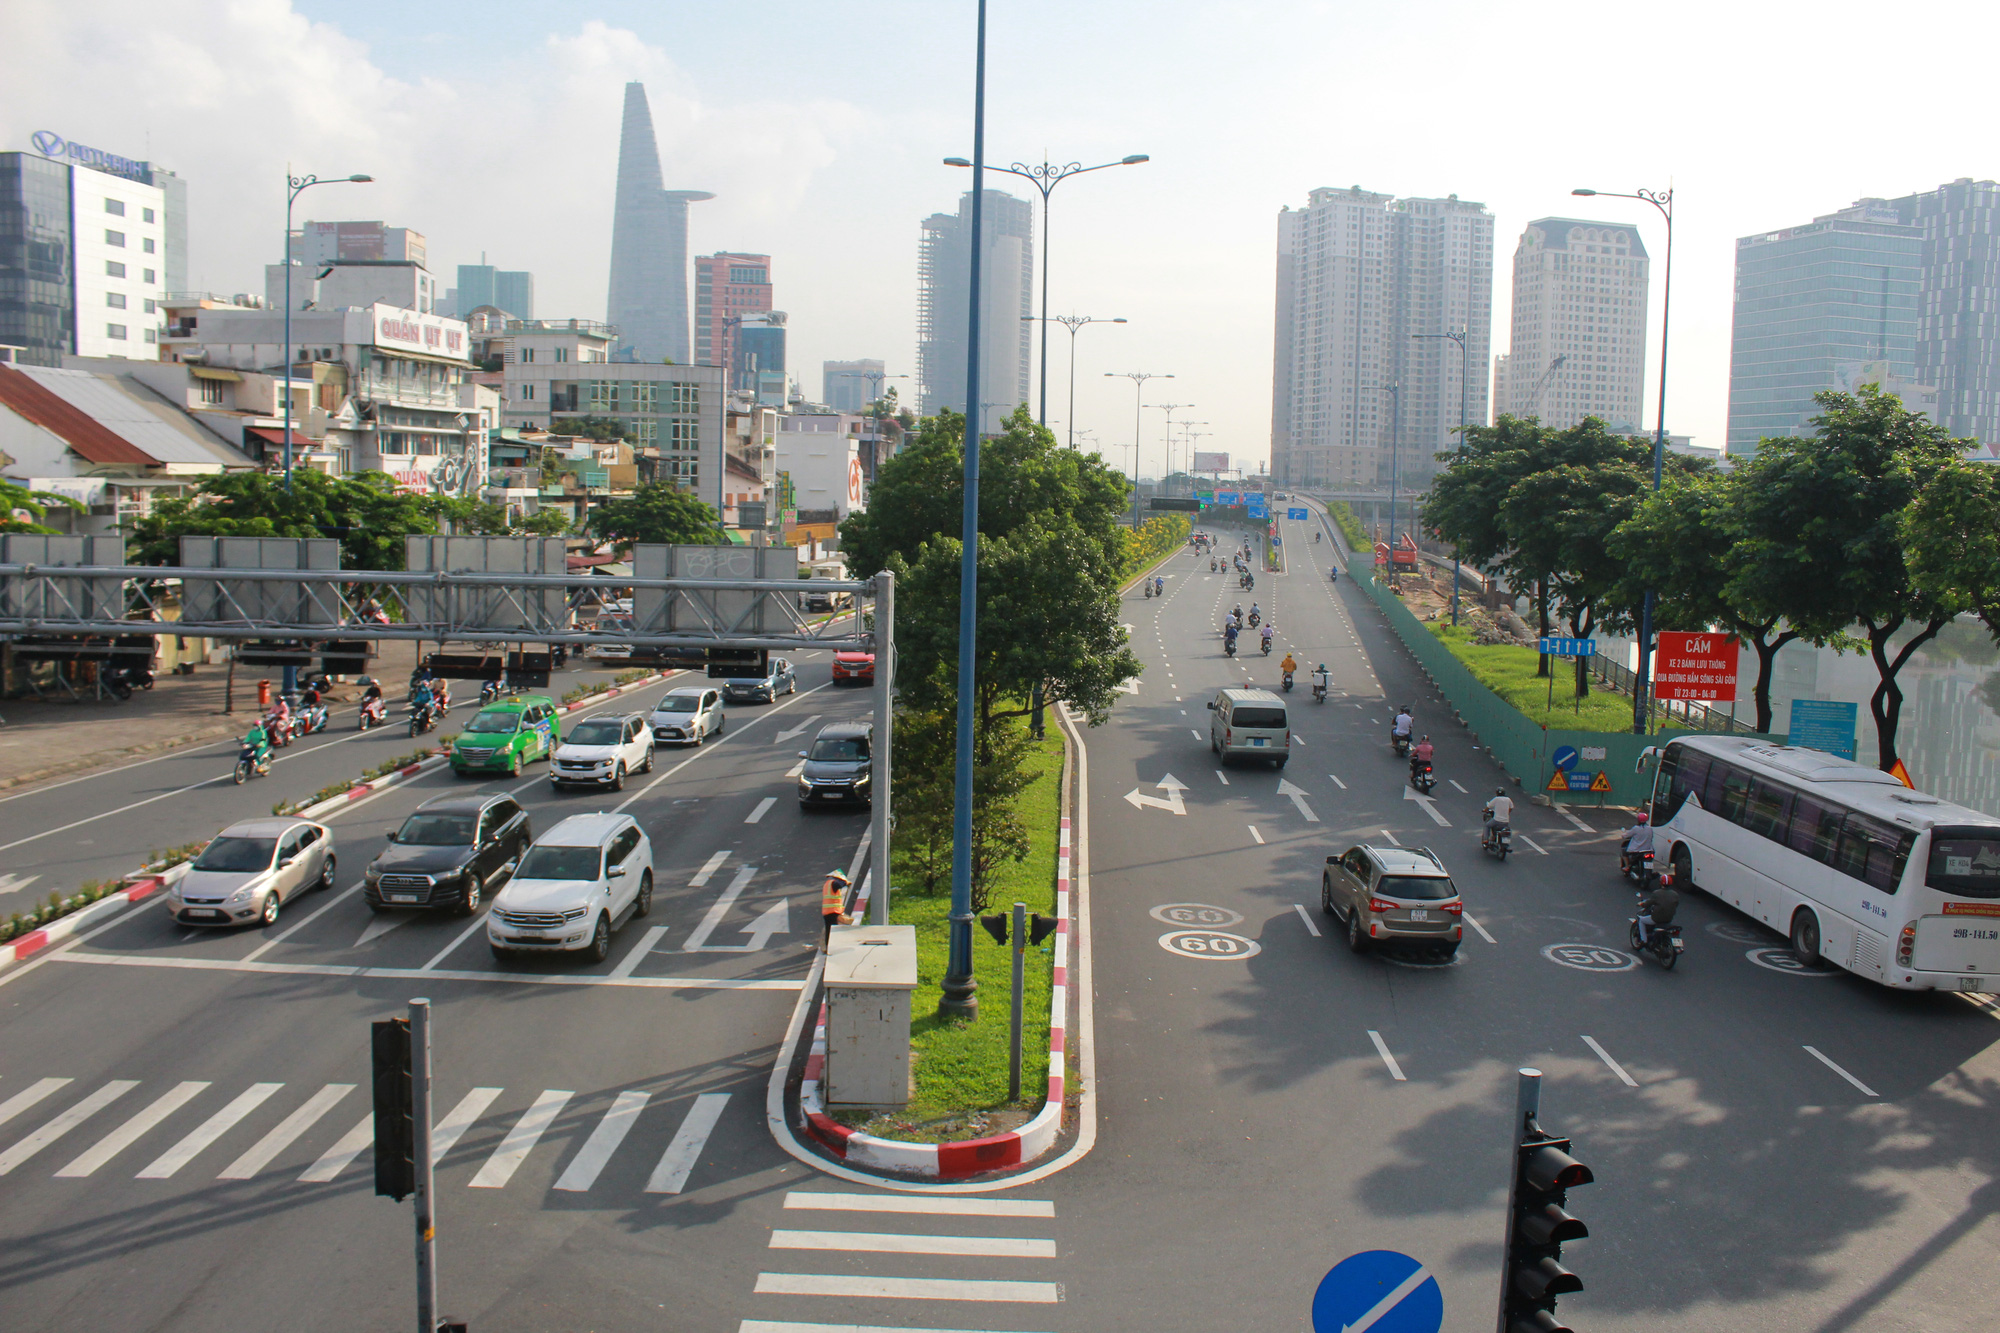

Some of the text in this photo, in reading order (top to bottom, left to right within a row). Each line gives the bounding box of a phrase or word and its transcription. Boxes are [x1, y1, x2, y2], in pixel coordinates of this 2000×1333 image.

[381, 313, 420, 344] QUÁN
[1685, 636, 1711, 653] CẤM
[1669, 659, 1676, 668] XE
[1677, 659, 1682, 668] 2
[1682, 689, 1697, 698] 23:00
[1170, 909, 1224, 922] 60
[1180, 937, 1238, 953] 60
[1558, 950, 1623, 965] 50
